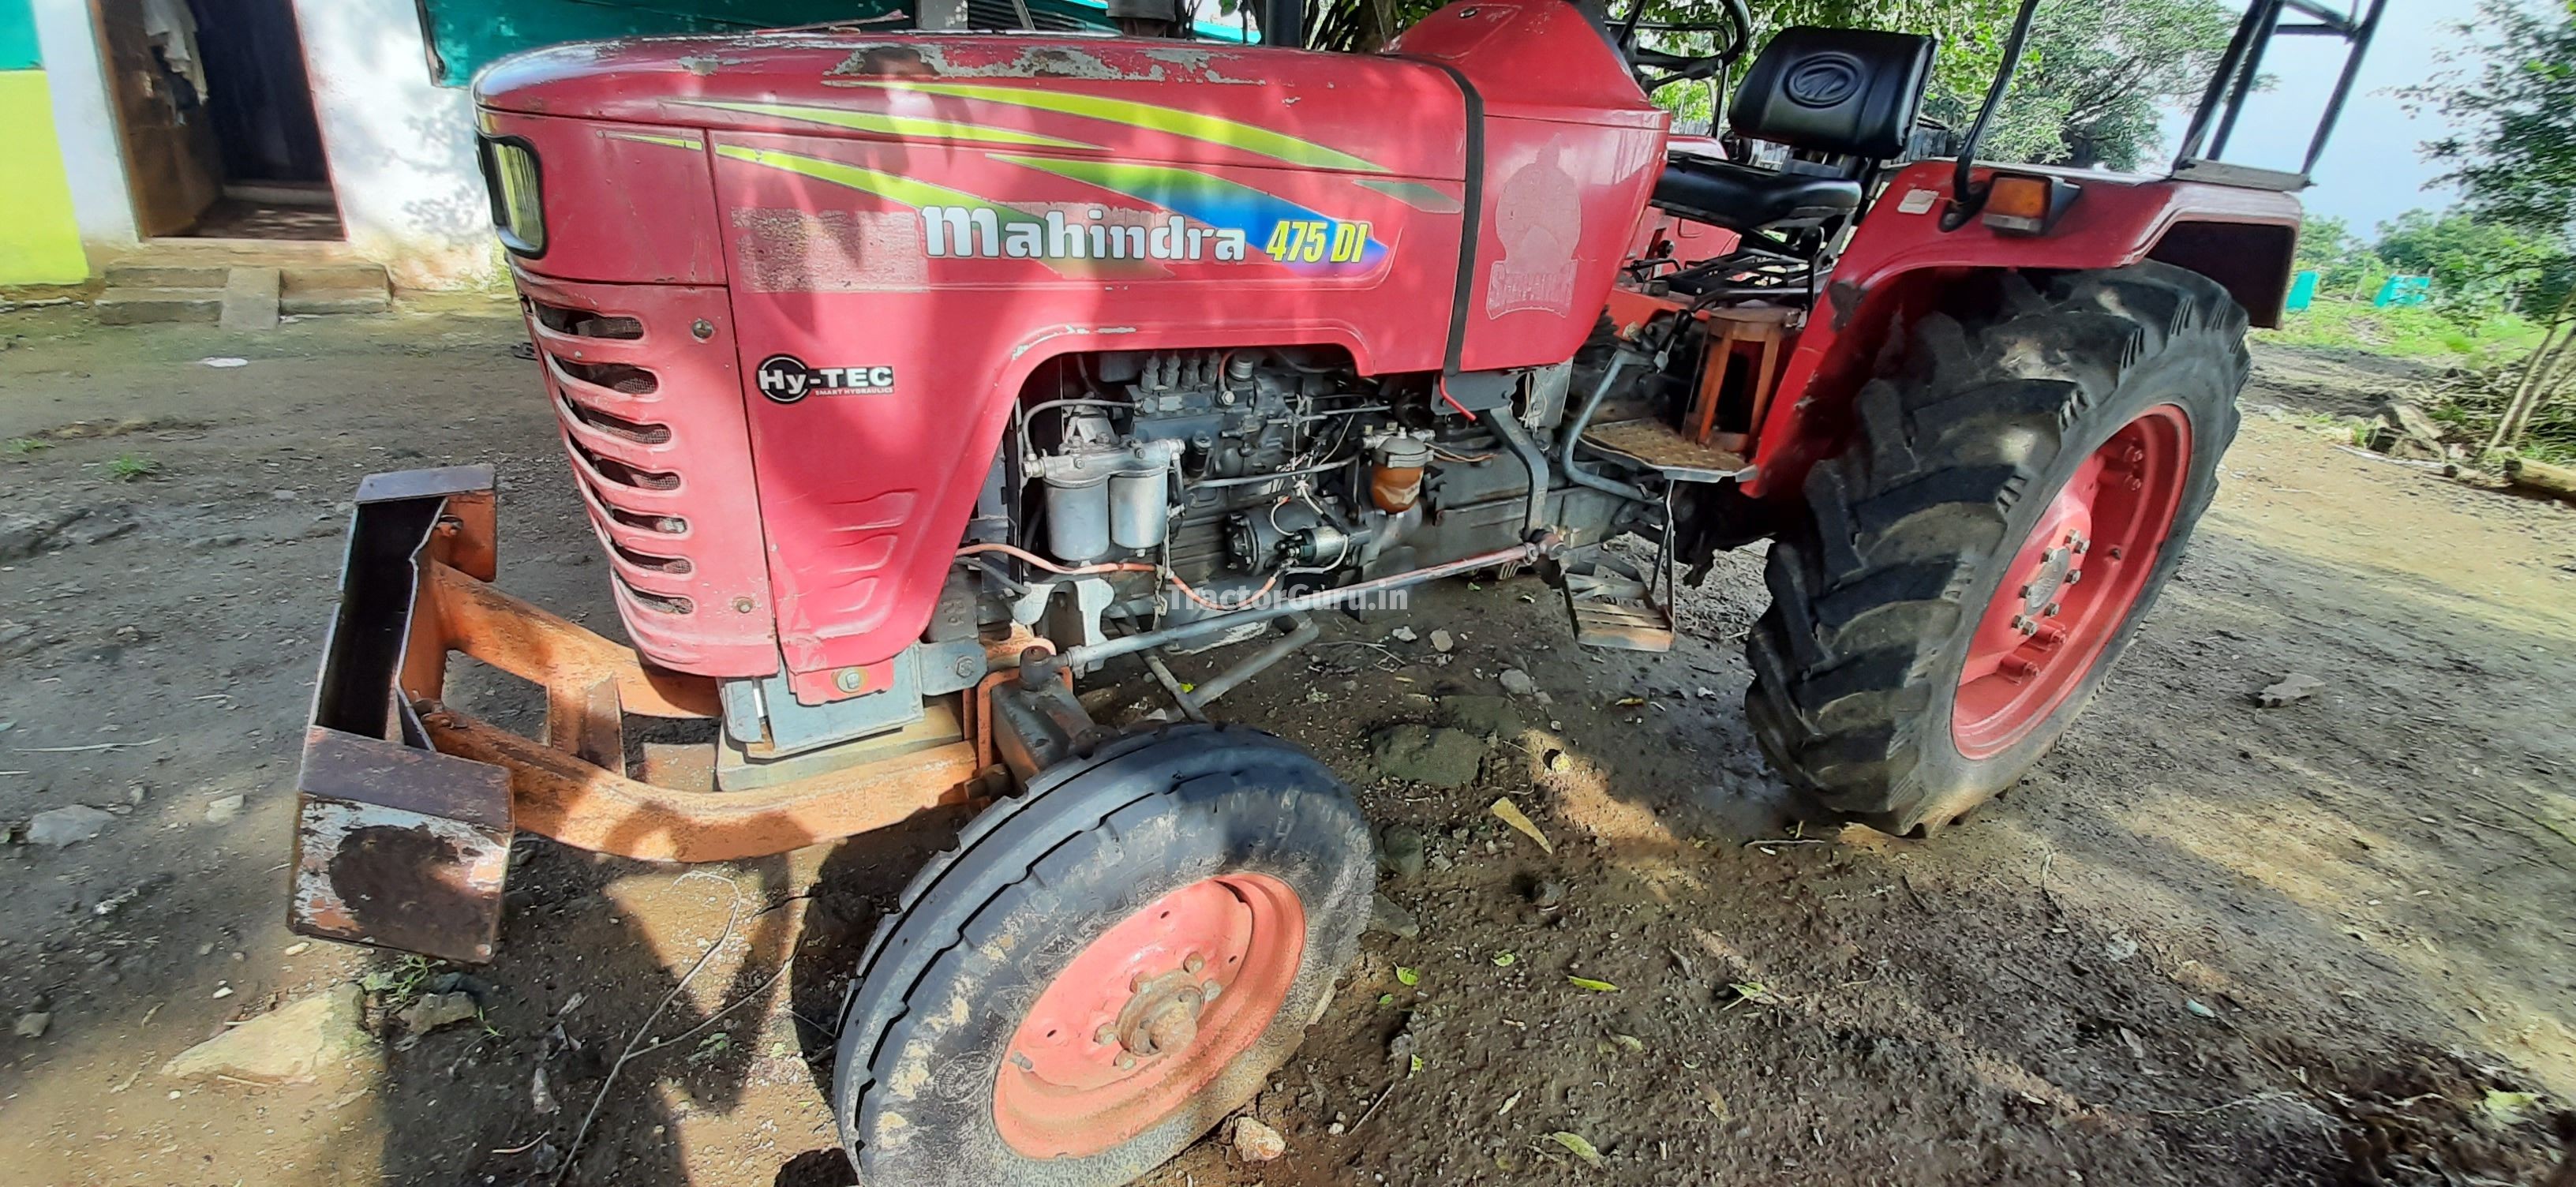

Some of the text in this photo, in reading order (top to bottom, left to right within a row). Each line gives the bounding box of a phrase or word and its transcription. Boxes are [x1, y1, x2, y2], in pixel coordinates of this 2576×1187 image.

[921, 205, 1368, 263] Mahindra 475 DI
[758, 367, 893, 394] Hy-TEC
